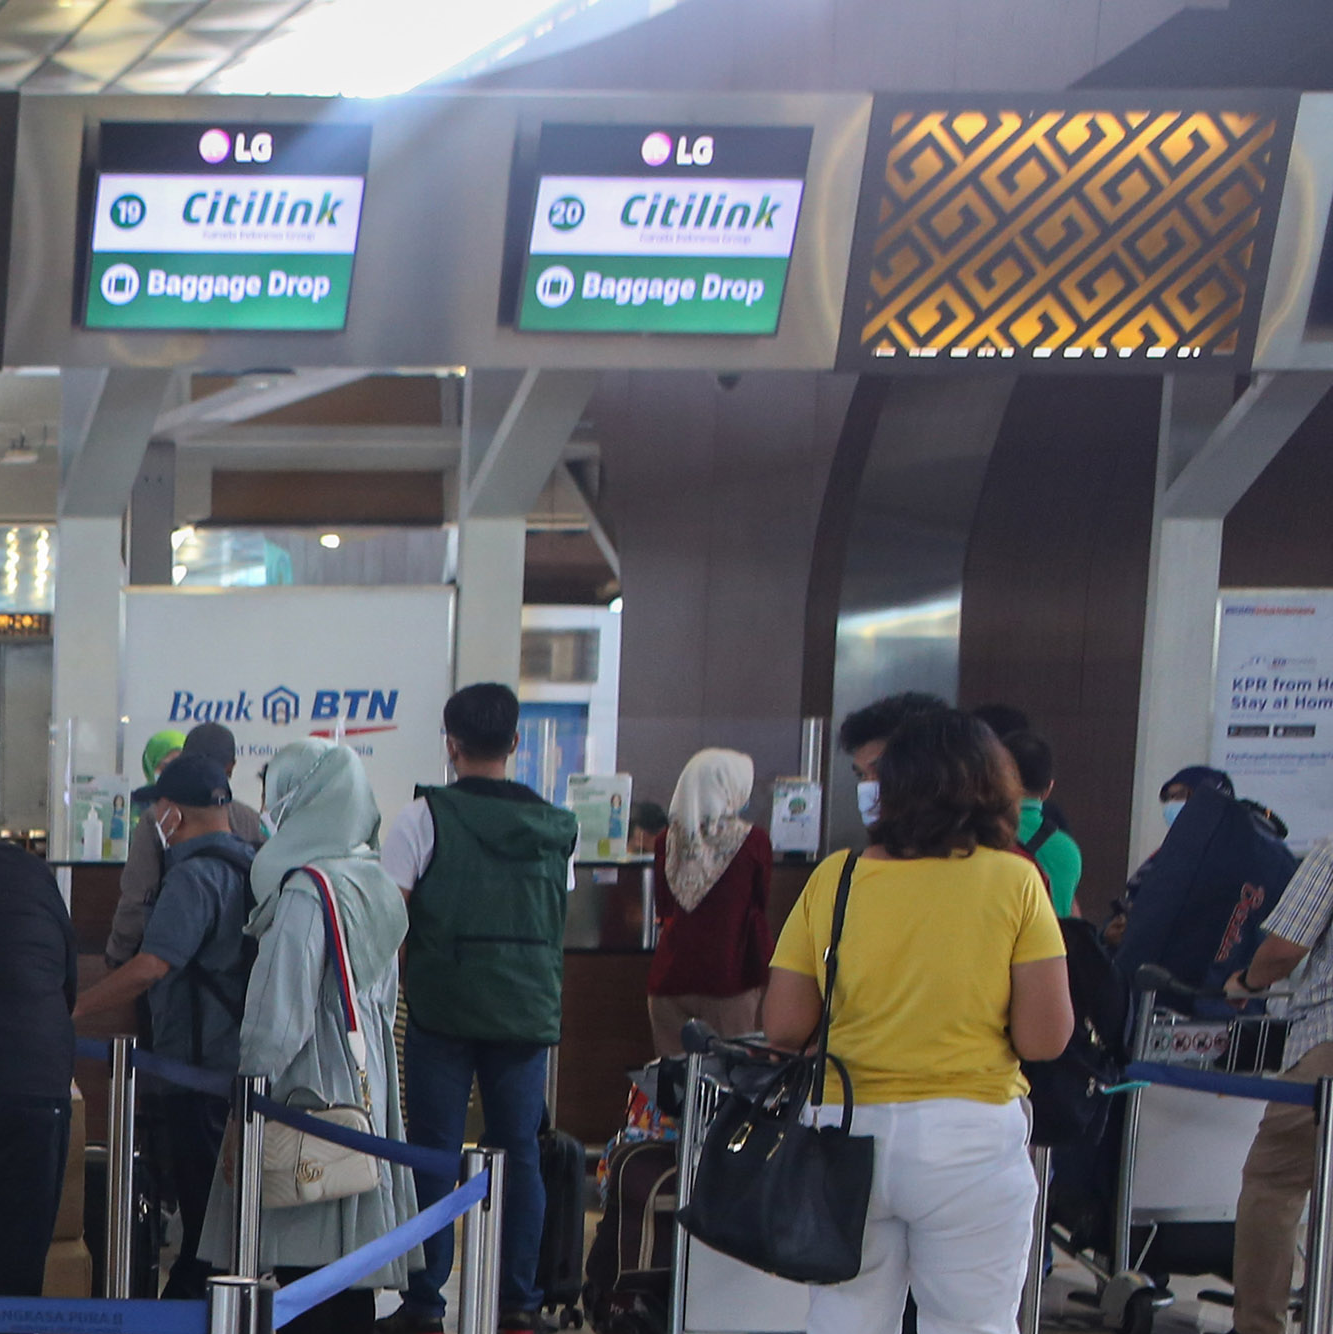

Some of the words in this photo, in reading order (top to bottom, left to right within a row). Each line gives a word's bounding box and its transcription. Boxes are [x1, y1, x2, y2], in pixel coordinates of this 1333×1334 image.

[235, 133, 273, 162] LG
[676, 136, 714, 165] LG
[116, 200, 140, 223] 19
[183, 191, 344, 225] Citilink
[551, 201, 582, 225] 20
[620, 193, 781, 229] Citilink
[147, 269, 261, 303] Baggage
[267, 270, 331, 303] Drop
[582, 271, 696, 306] Baggage
[702, 272, 764, 306] Drop
[1232, 677, 1268, 692] KPR
[1273, 677, 1312, 692] from
[168, 690, 252, 722] Bank
[311, 689, 399, 720] BTN
[1231, 696, 1269, 712] Stay
[1273, 697, 1288, 710] at
[1295, 697, 1333, 710] Hom
